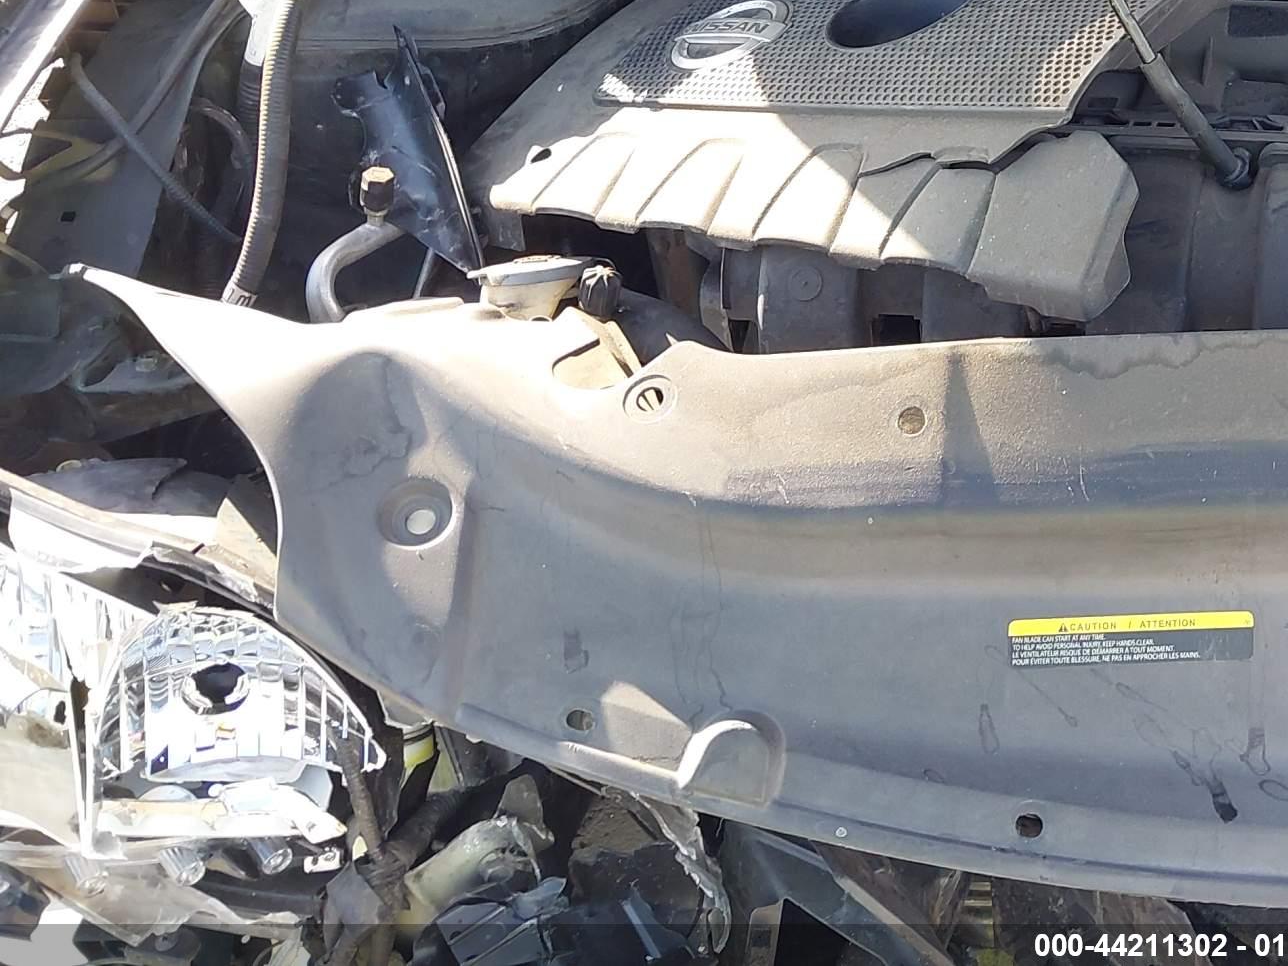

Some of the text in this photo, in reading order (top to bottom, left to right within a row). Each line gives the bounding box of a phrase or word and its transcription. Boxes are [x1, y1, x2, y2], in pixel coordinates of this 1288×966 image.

[684, 20, 770, 34] NISSAN
[1070, 622, 1116, 631] CAUTION
[1139, 619, 1196, 628] ATTENTION
[1012, 636, 1024, 644] FAN
[1042, 635, 1054, 643] CAN
[1021, 643, 1036, 651] HELP
[1054, 642, 1081, 650] PERSONAL
[1103, 640, 1116, 648] KEEP
[1116, 639, 1135, 647] HANDS
[1083, 648, 1091, 656] DE
[1130, 645, 1146, 654] TOUT
[1012, 658, 1030, 666] POUR
[1051, 656, 1070, 664] TOUTE
[1111, 653, 1123, 662] PAS
[1123, 653, 1132, 661] EN
[1132, 652, 1168, 661] APPROCHER
[1168, 651, 1179, 660] LES
